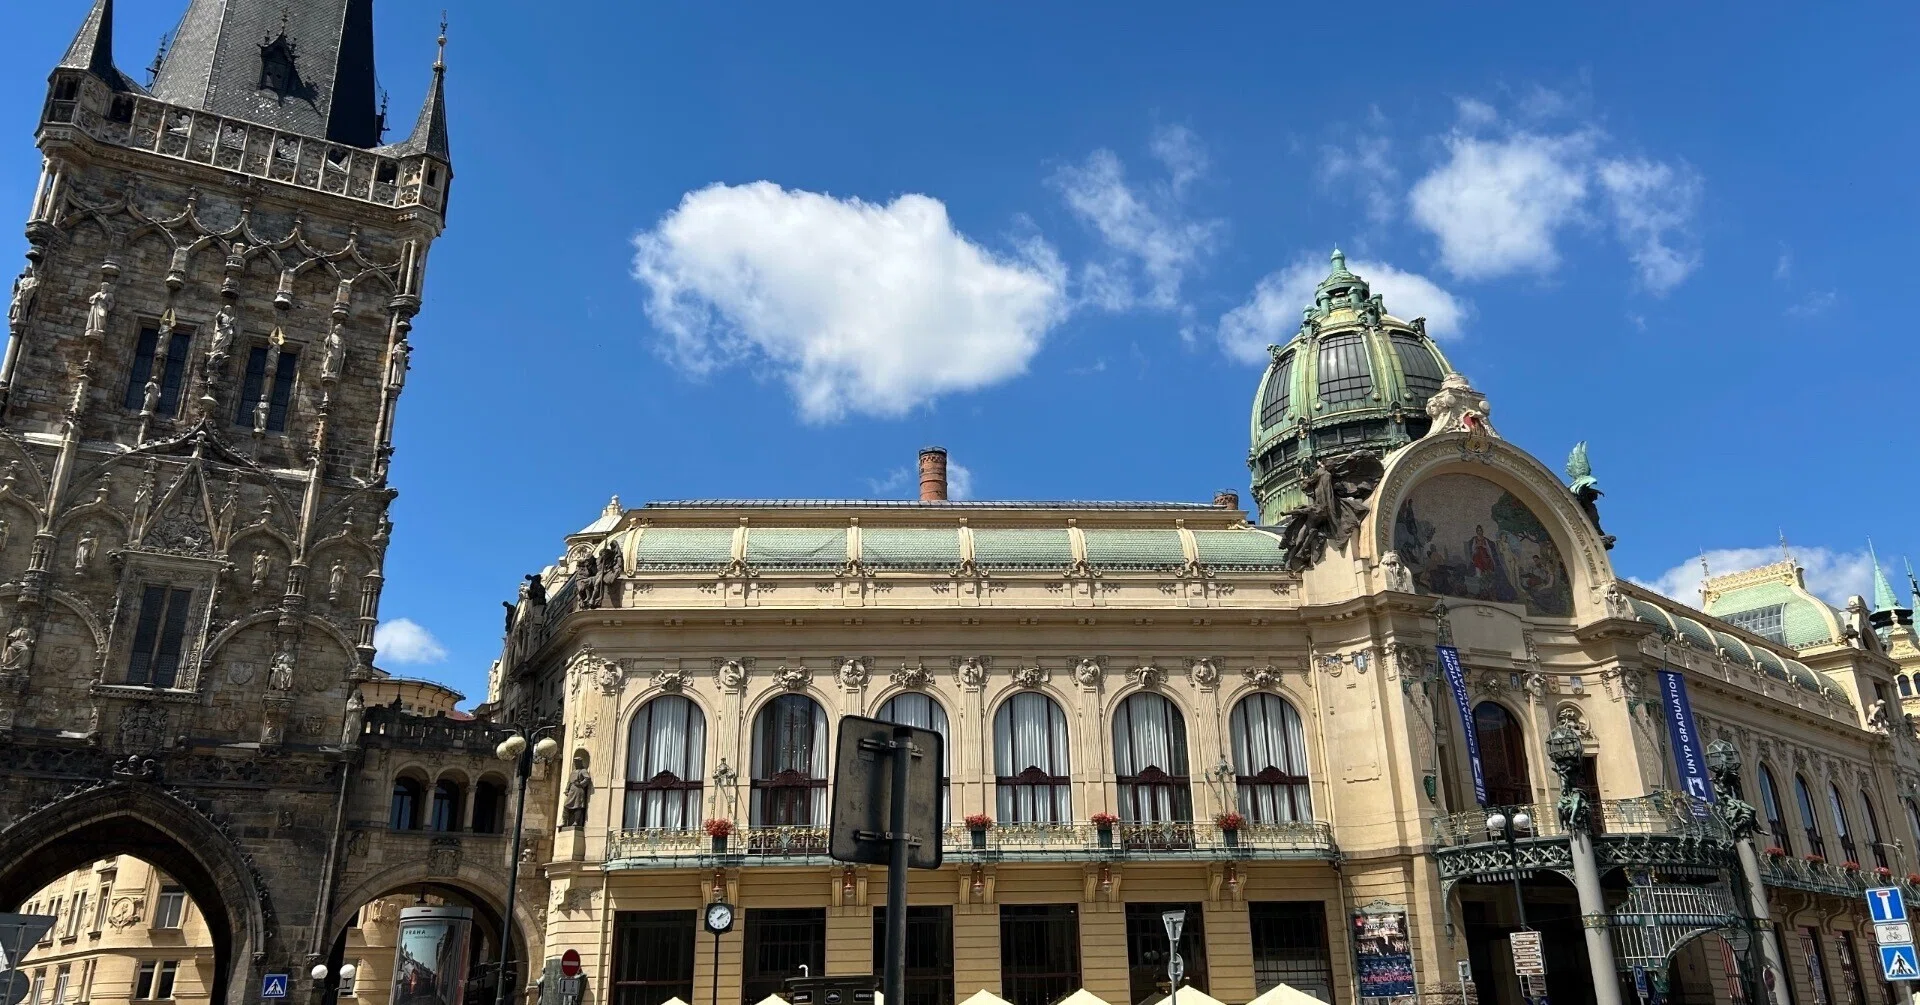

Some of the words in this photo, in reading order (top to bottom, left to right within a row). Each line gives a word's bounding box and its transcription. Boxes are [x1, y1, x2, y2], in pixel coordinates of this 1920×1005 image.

[1441, 649, 1475, 754] CONGRATULATIONS
[1666, 673, 1689, 743] GRADUATION
[1683, 745, 1698, 774] UNYP
